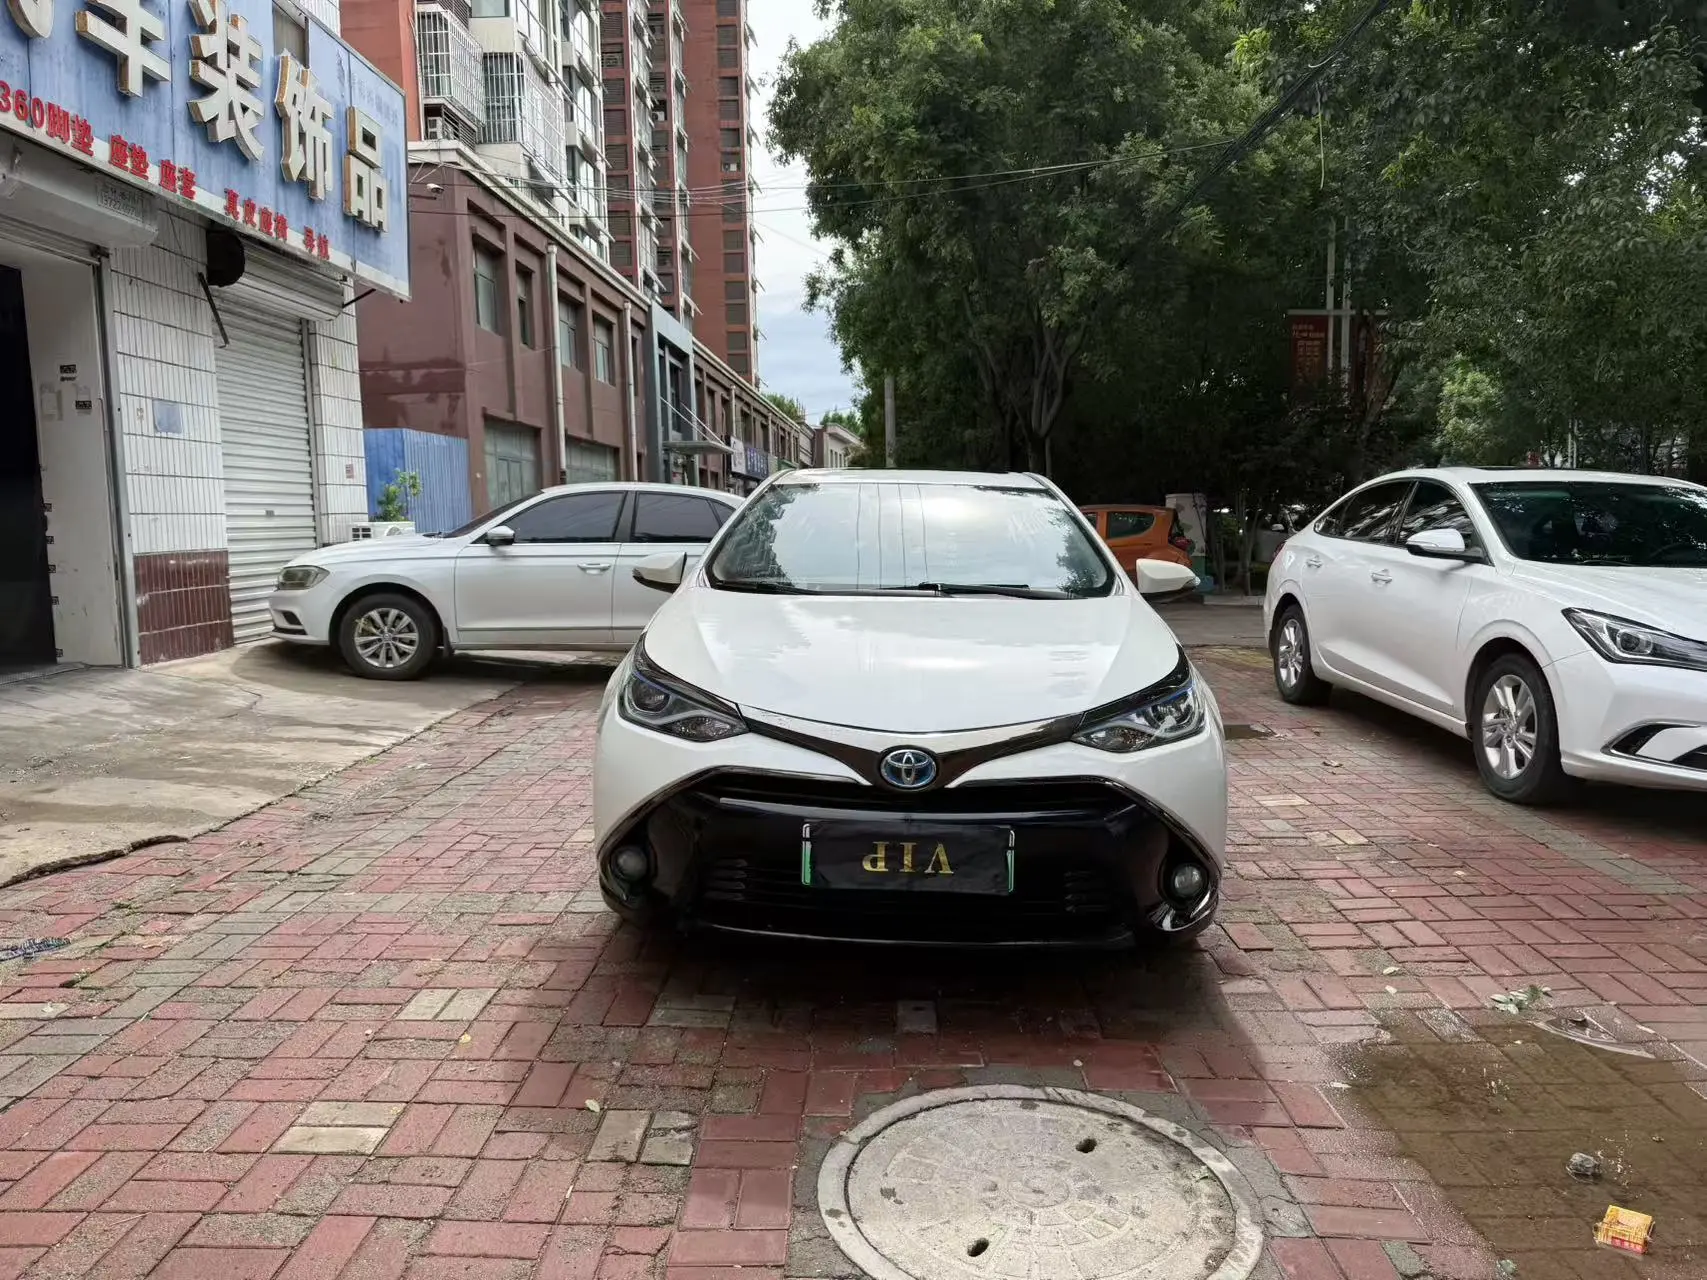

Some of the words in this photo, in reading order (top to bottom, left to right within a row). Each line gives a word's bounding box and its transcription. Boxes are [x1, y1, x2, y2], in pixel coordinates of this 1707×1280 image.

[0, 80, 94, 157] 360脚垫
[110, 134, 150, 180] 座垫
[159, 159, 196, 200] 座套
[224, 188, 288, 242] 真皮座椅
[862, 840, 955, 875] VIP
